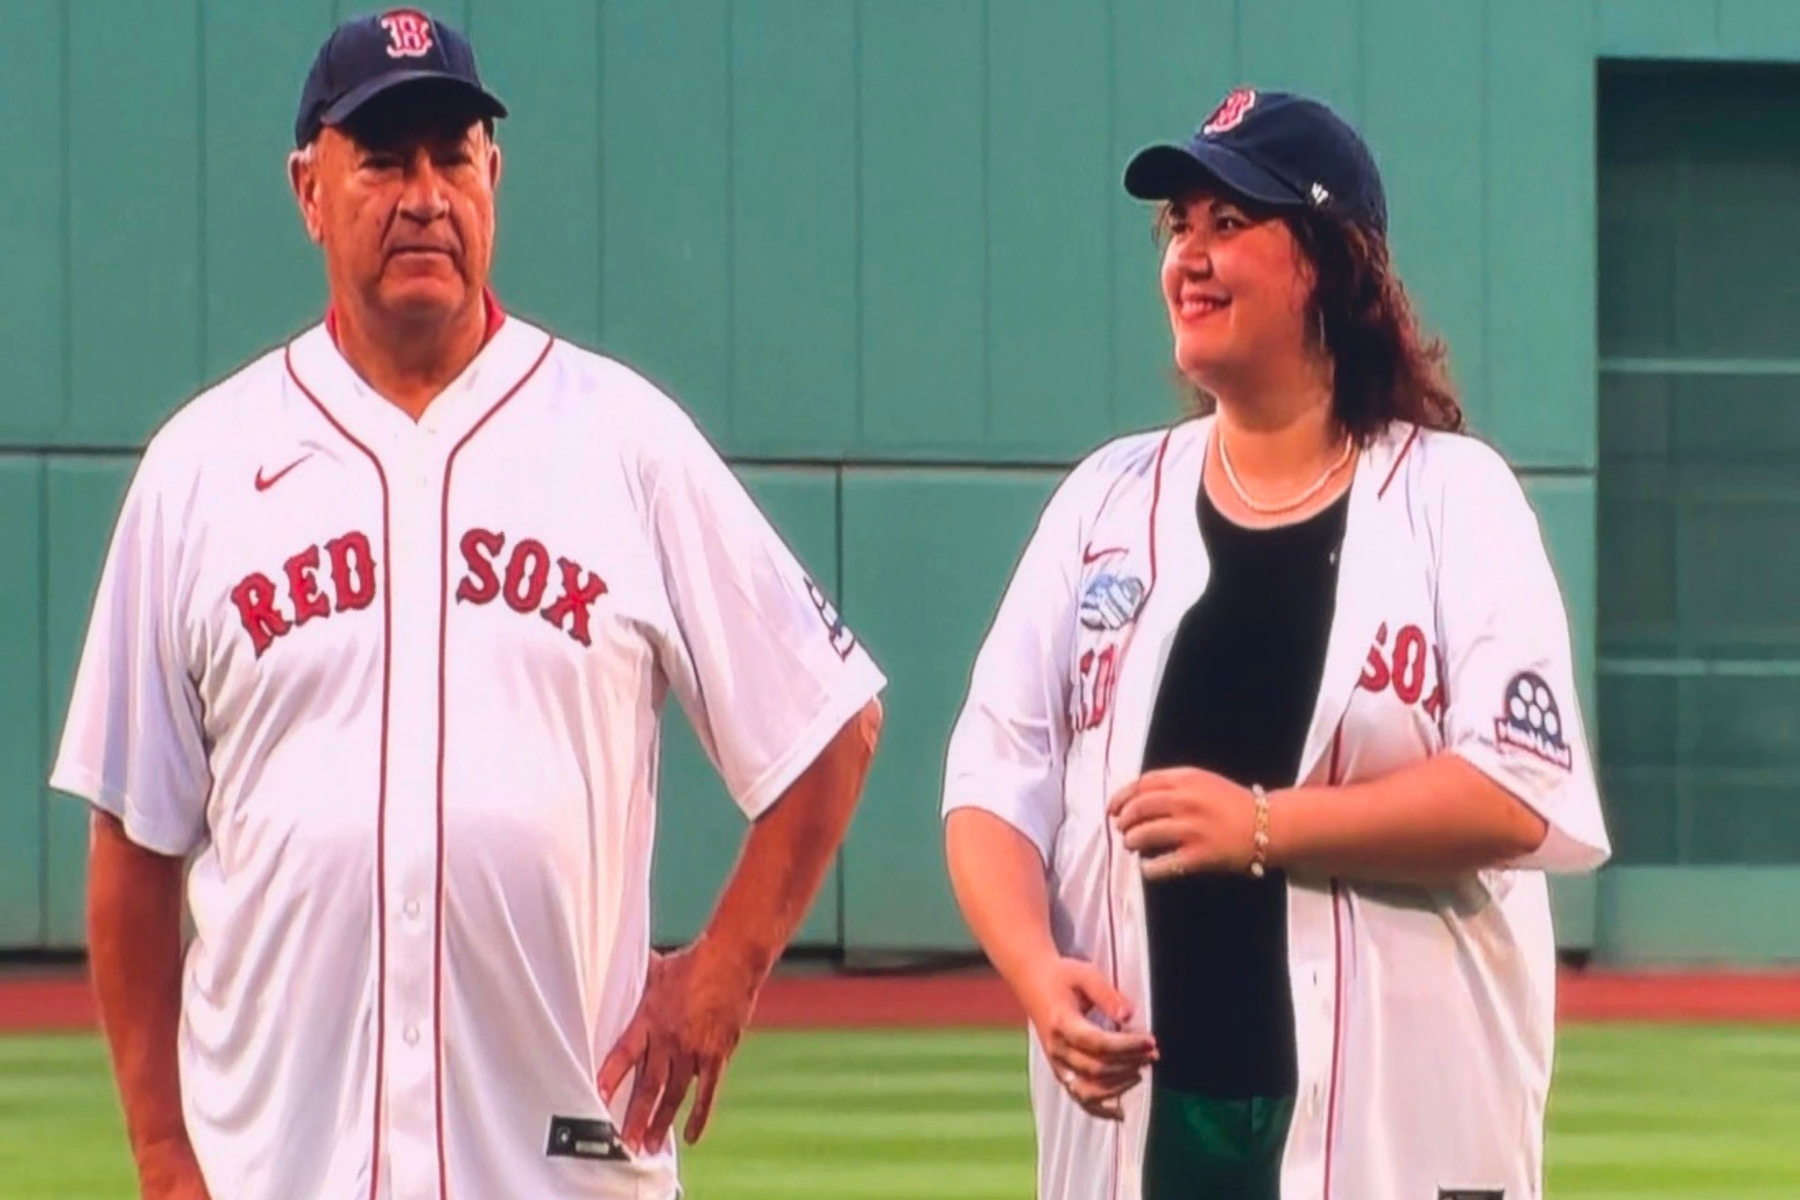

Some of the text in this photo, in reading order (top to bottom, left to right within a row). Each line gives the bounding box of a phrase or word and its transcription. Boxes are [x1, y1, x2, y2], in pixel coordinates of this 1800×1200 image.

[381, 8, 433, 58] B
[231, 527, 609, 658] RED SOX
